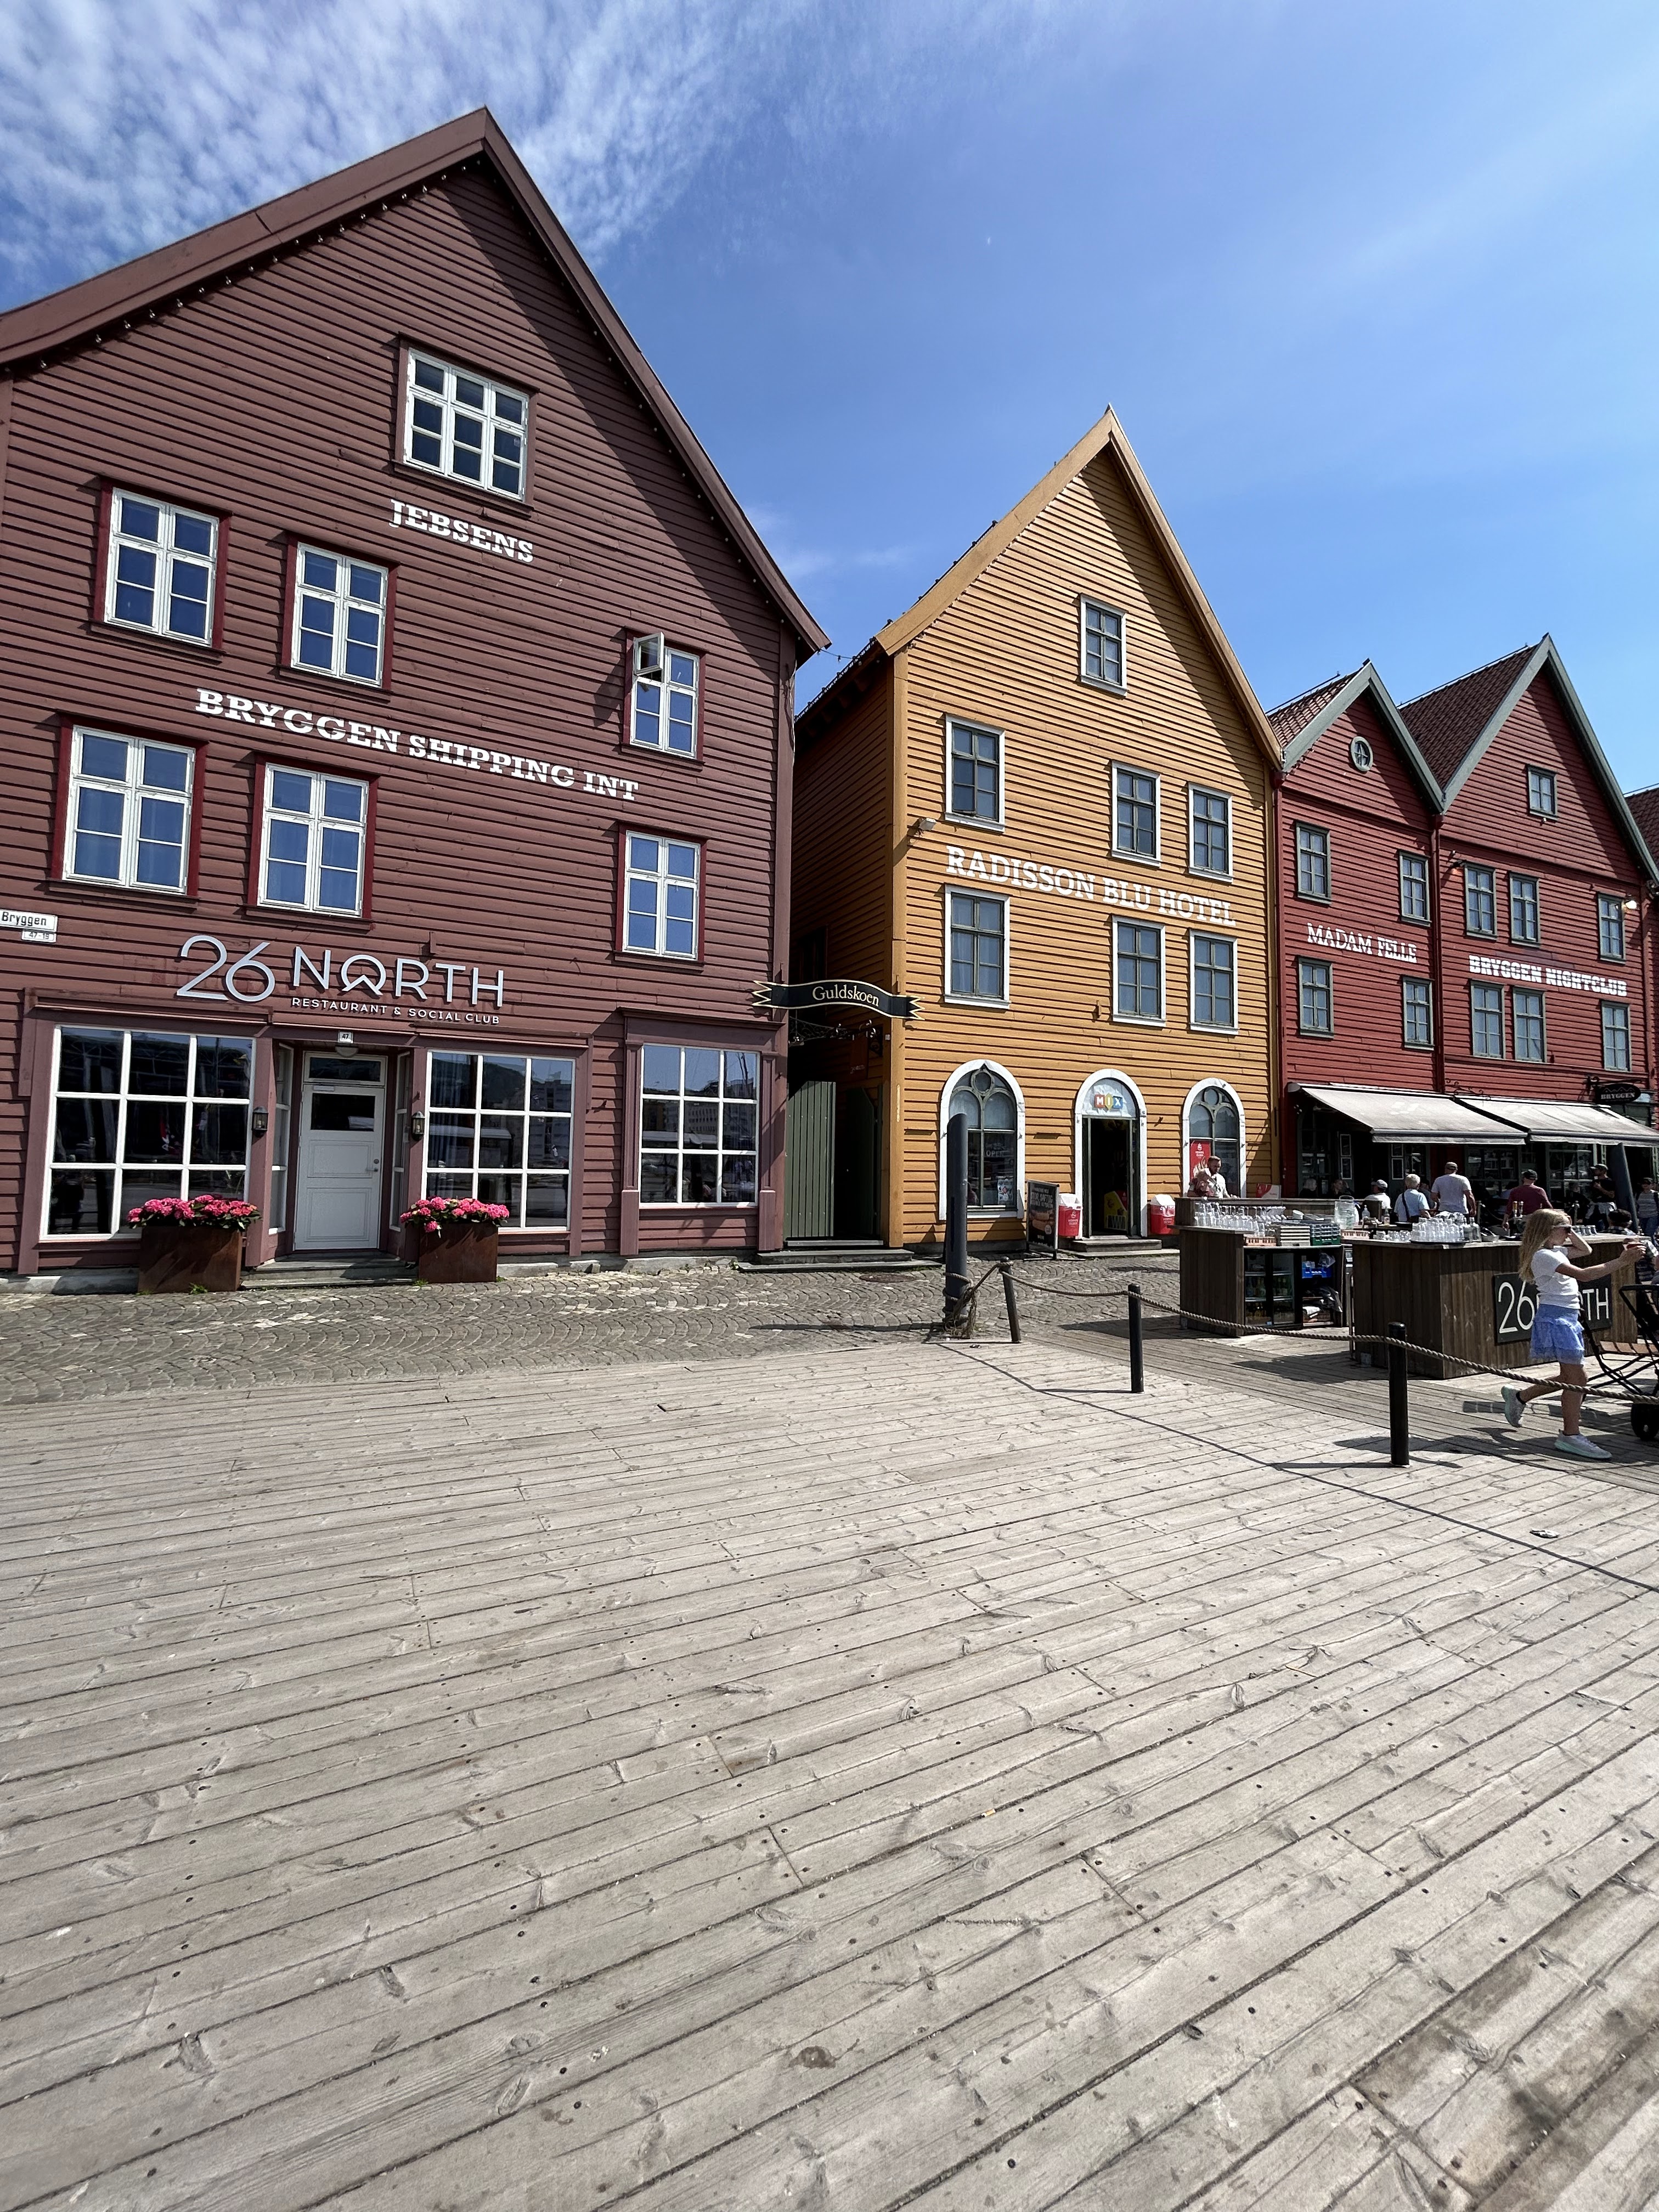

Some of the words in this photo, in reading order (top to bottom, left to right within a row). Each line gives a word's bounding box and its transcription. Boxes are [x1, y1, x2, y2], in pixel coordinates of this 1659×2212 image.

[390, 499, 534, 563] JEBSENS
[195, 688, 401, 754] BRYGGEN
[409, 735, 575, 788] SHIPPING
[583, 770, 639, 801] INT
[945, 845, 1096, 900] RADISSON
[1102, 877, 1152, 911] BLU
[1157, 888, 1237, 926] HOTEL
[2, 911, 47, 927] Bryggen
[1307, 922, 1373, 955] MADAM
[1377, 936, 1418, 963] FELLE
[176, 934, 275, 1002] 26
[293, 946, 504, 1008] NORTH
[1469, 955, 1542, 983] BRYGGEN
[1545, 968, 1627, 997] NIGHTCLUB
[292, 997, 388, 1014] RESTAURANT
[394, 1006, 401, 1015] &
[408, 1008, 461, 1021] SOCIAL
[465, 1013, 500, 1024] CLUB
[812, 984, 879, 1007] Guldskoen
[1096, 1095, 1122, 1107] MIX
[1498, 1280, 1535, 1334] 26
